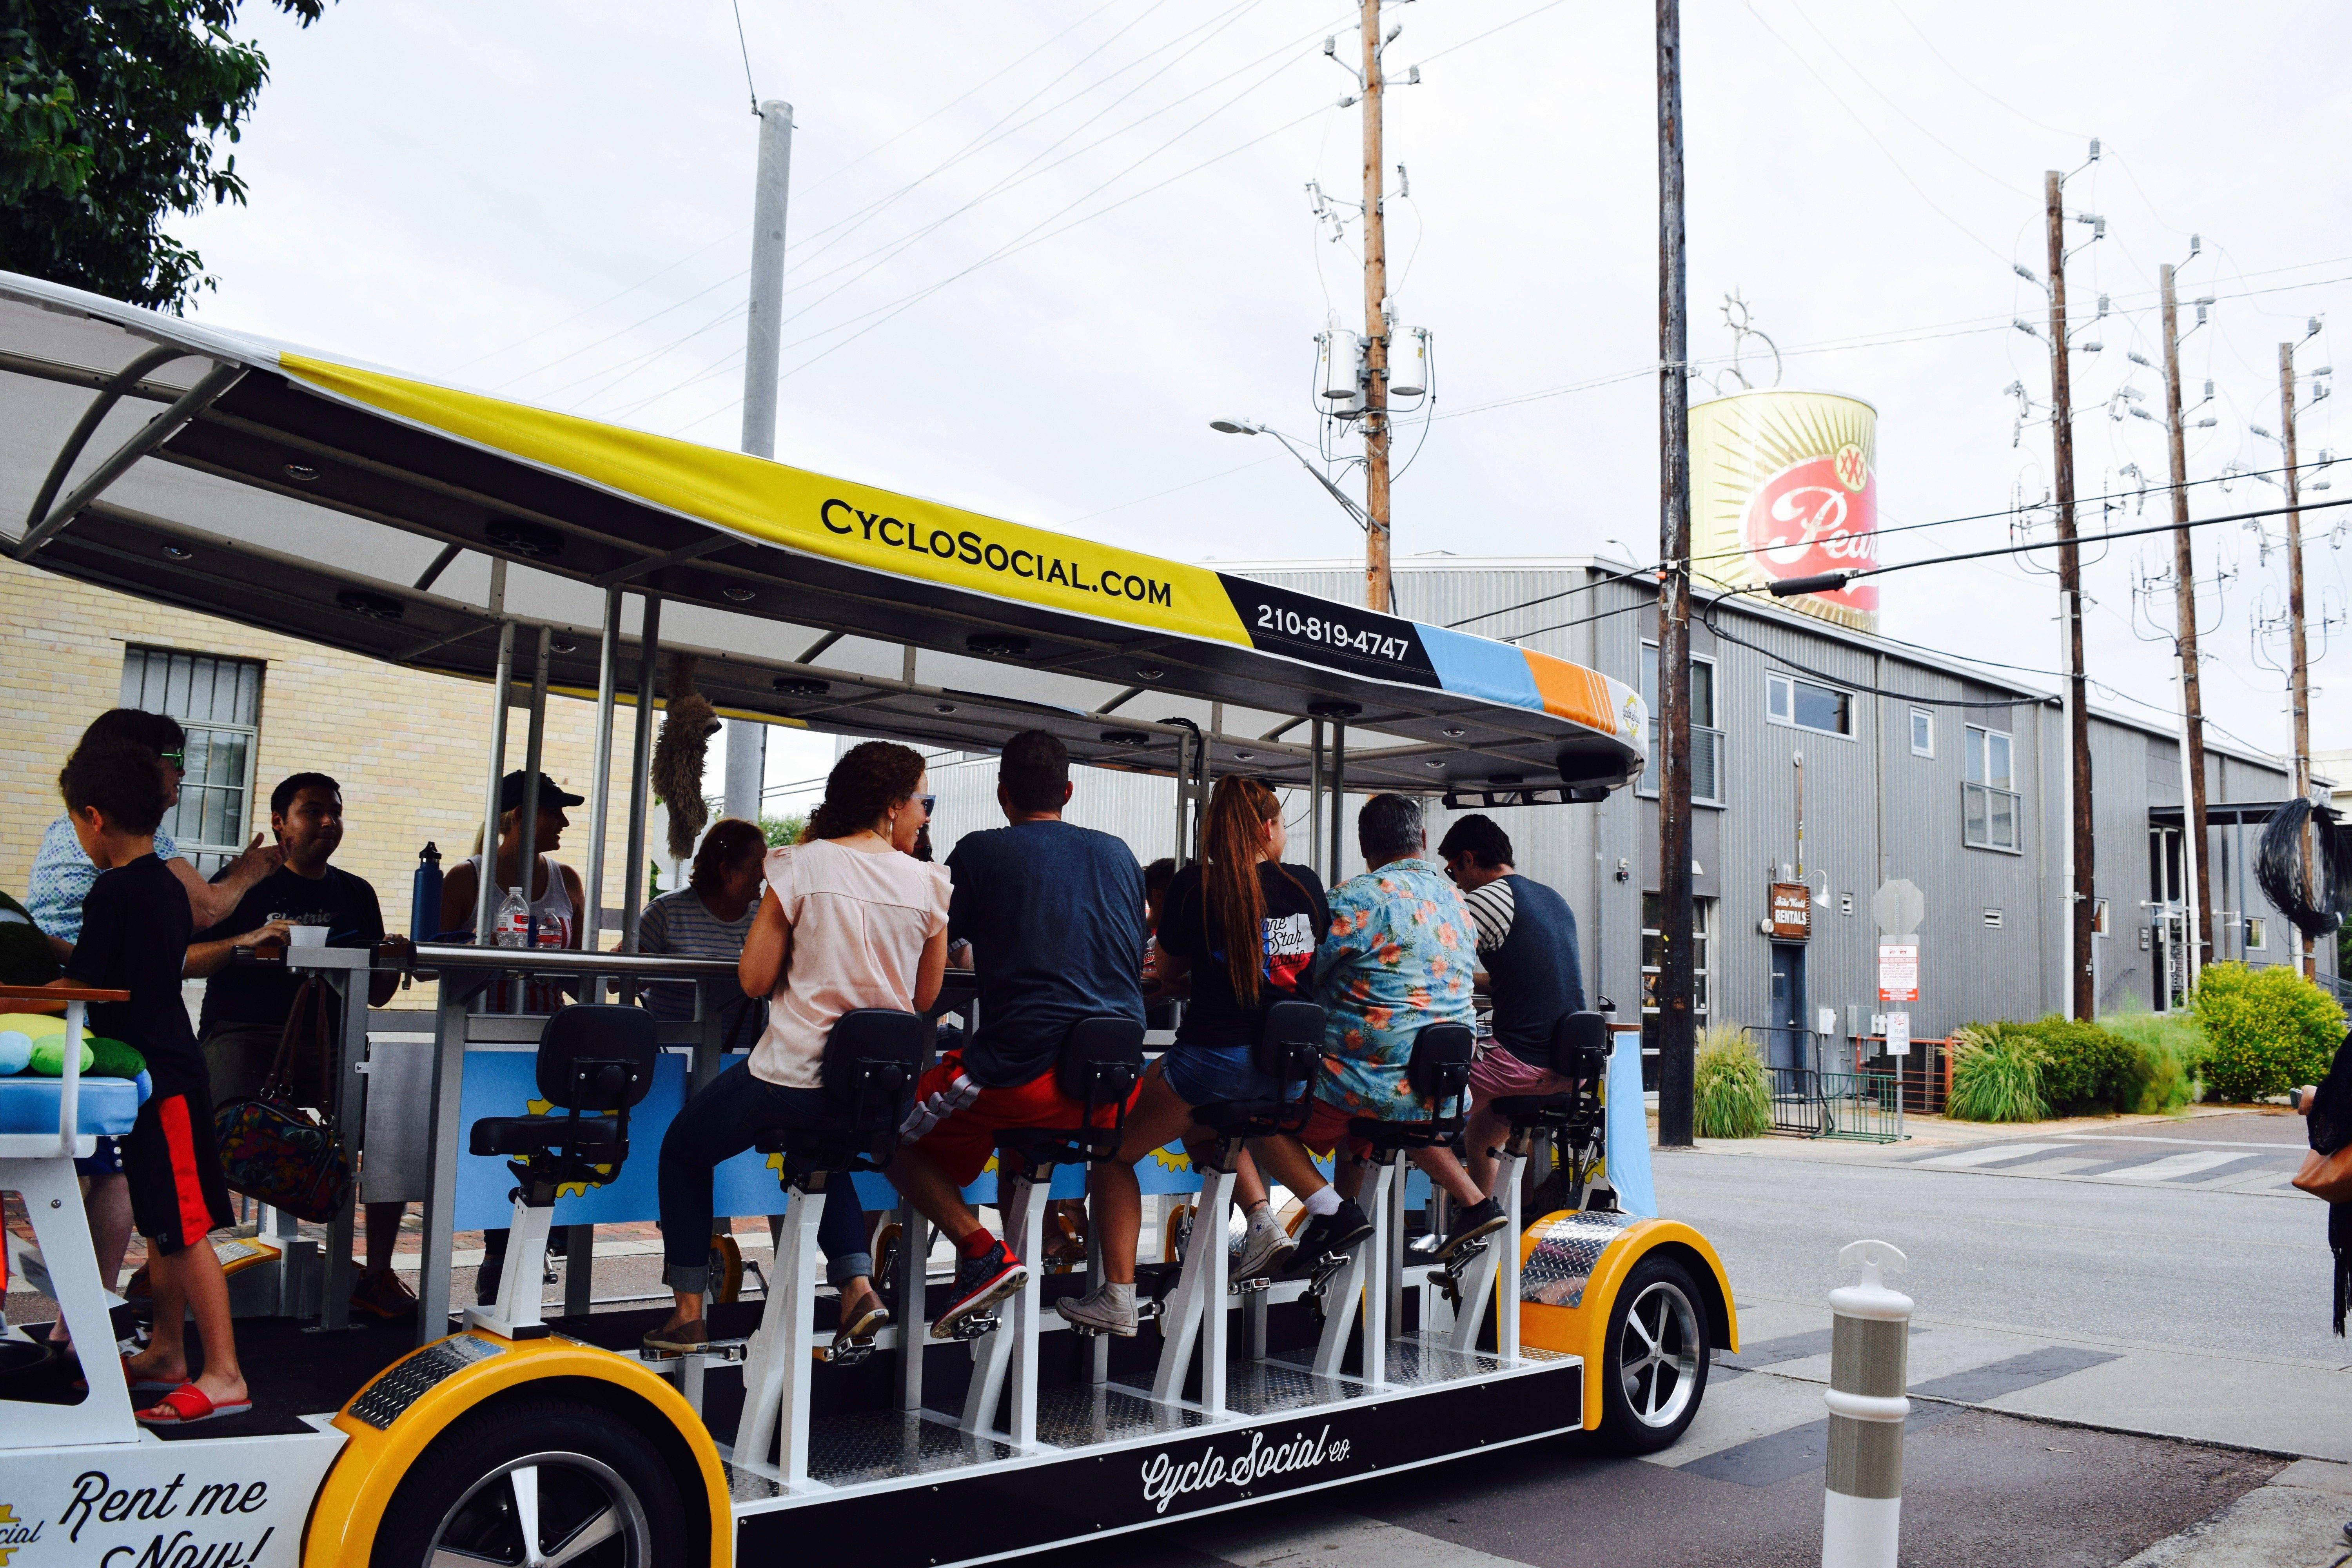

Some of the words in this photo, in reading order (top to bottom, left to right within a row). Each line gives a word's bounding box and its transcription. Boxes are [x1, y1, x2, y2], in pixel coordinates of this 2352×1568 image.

[1258, 604, 1408, 661] 210-819-4747
[1260, 918, 1287, 932] one
[1775, 909, 1806, 925] RENTALS
[1263, 931, 1304, 956] Star
[58, 1471, 186, 1543] Rent
[185, 1481, 267, 1516] me
